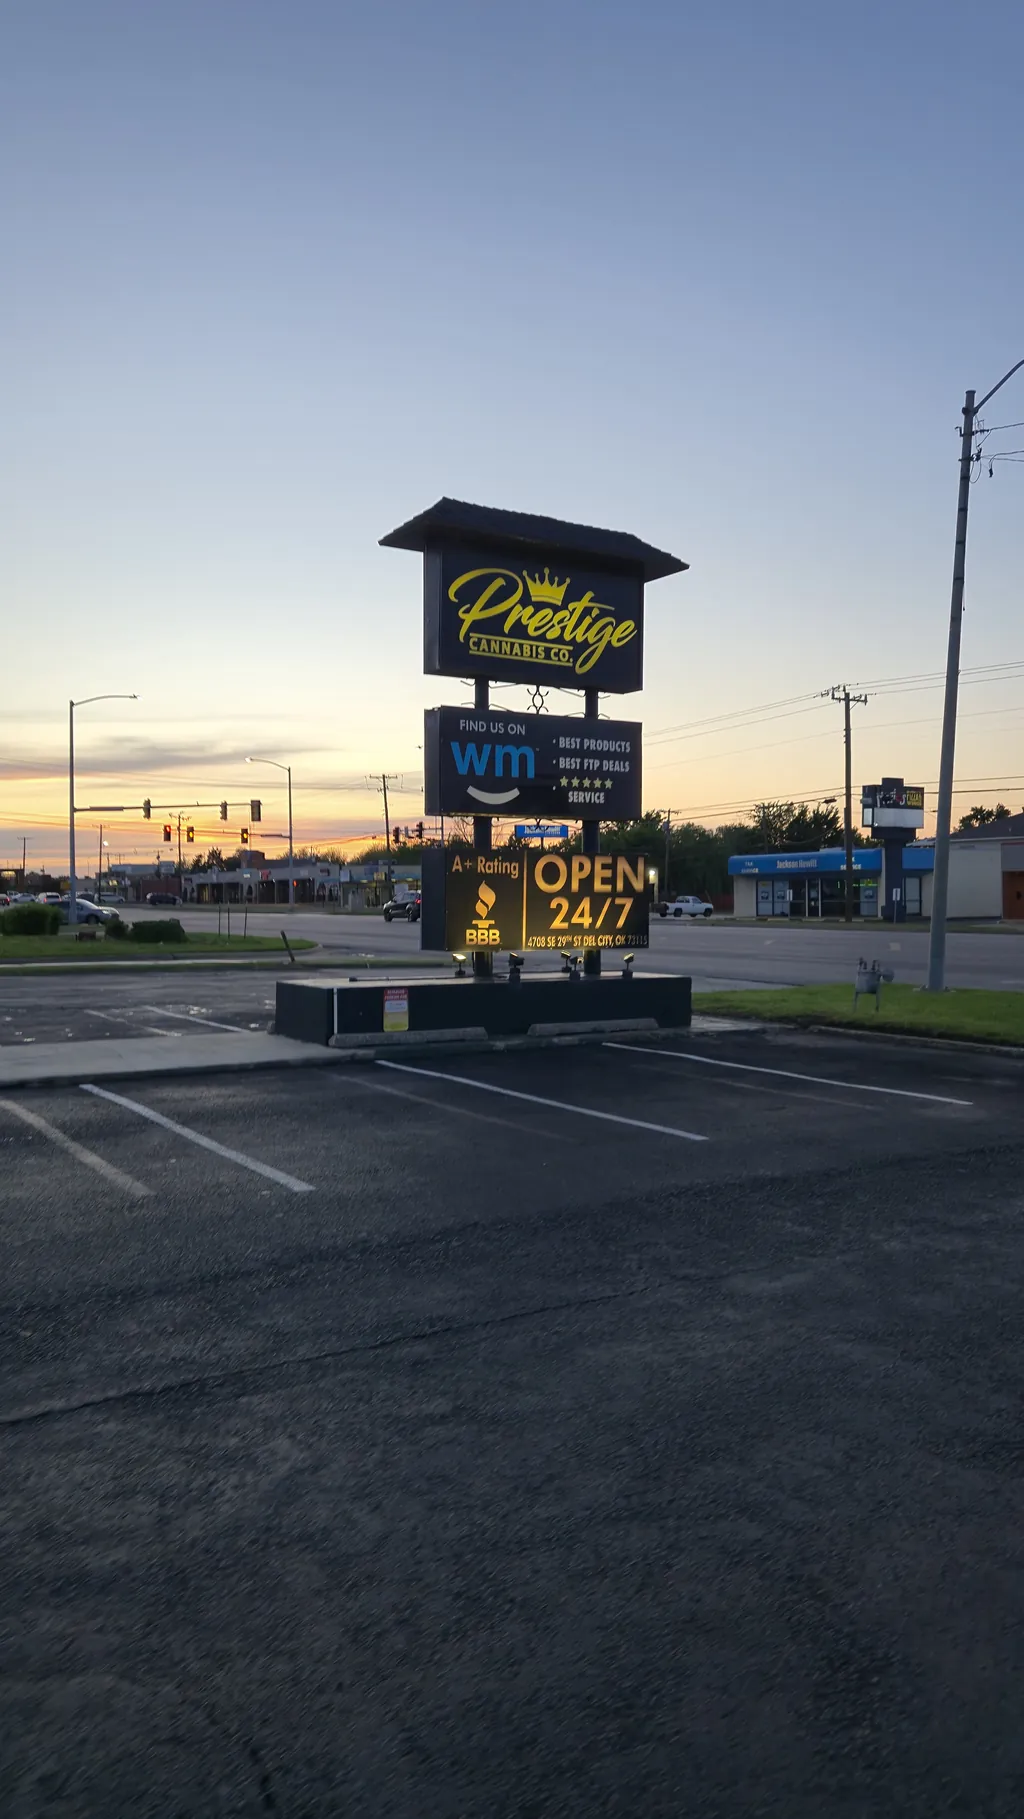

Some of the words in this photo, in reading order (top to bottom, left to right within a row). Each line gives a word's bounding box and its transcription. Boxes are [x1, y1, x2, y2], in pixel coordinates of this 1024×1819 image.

[448, 567, 637, 674] Prestige
[469, 637, 545, 660] CANNABIS
[550, 648, 573, 663] CO.
[460, 719, 487, 733] FIND
[490, 721, 504, 734] US
[507, 723, 526, 736] ON
[559, 736, 581, 749] BEST
[583, 738, 631, 753] PRODUCTS
[450, 741, 535, 779] wm
[559, 757, 581, 770] BEST
[583, 758, 601, 771] FTP
[602, 759, 631, 772] DEALS
[568, 791, 605, 804] SERVICE
[452, 855, 473, 873] A+
[477, 856, 519, 879] Rating
[776, 859, 798, 869] Jackson
[534, 854, 645, 893] OPEN
[549, 896, 634, 929] 24/7
[465, 929, 501, 945] BBB
[527, 935, 546, 948] 4708
[547, 935, 556, 948] SE
[573, 934, 582, 947] ST
[583, 934, 597, 947] DEL
[615, 934, 626, 946] OK
[627, 934, 648, 945] 73115
